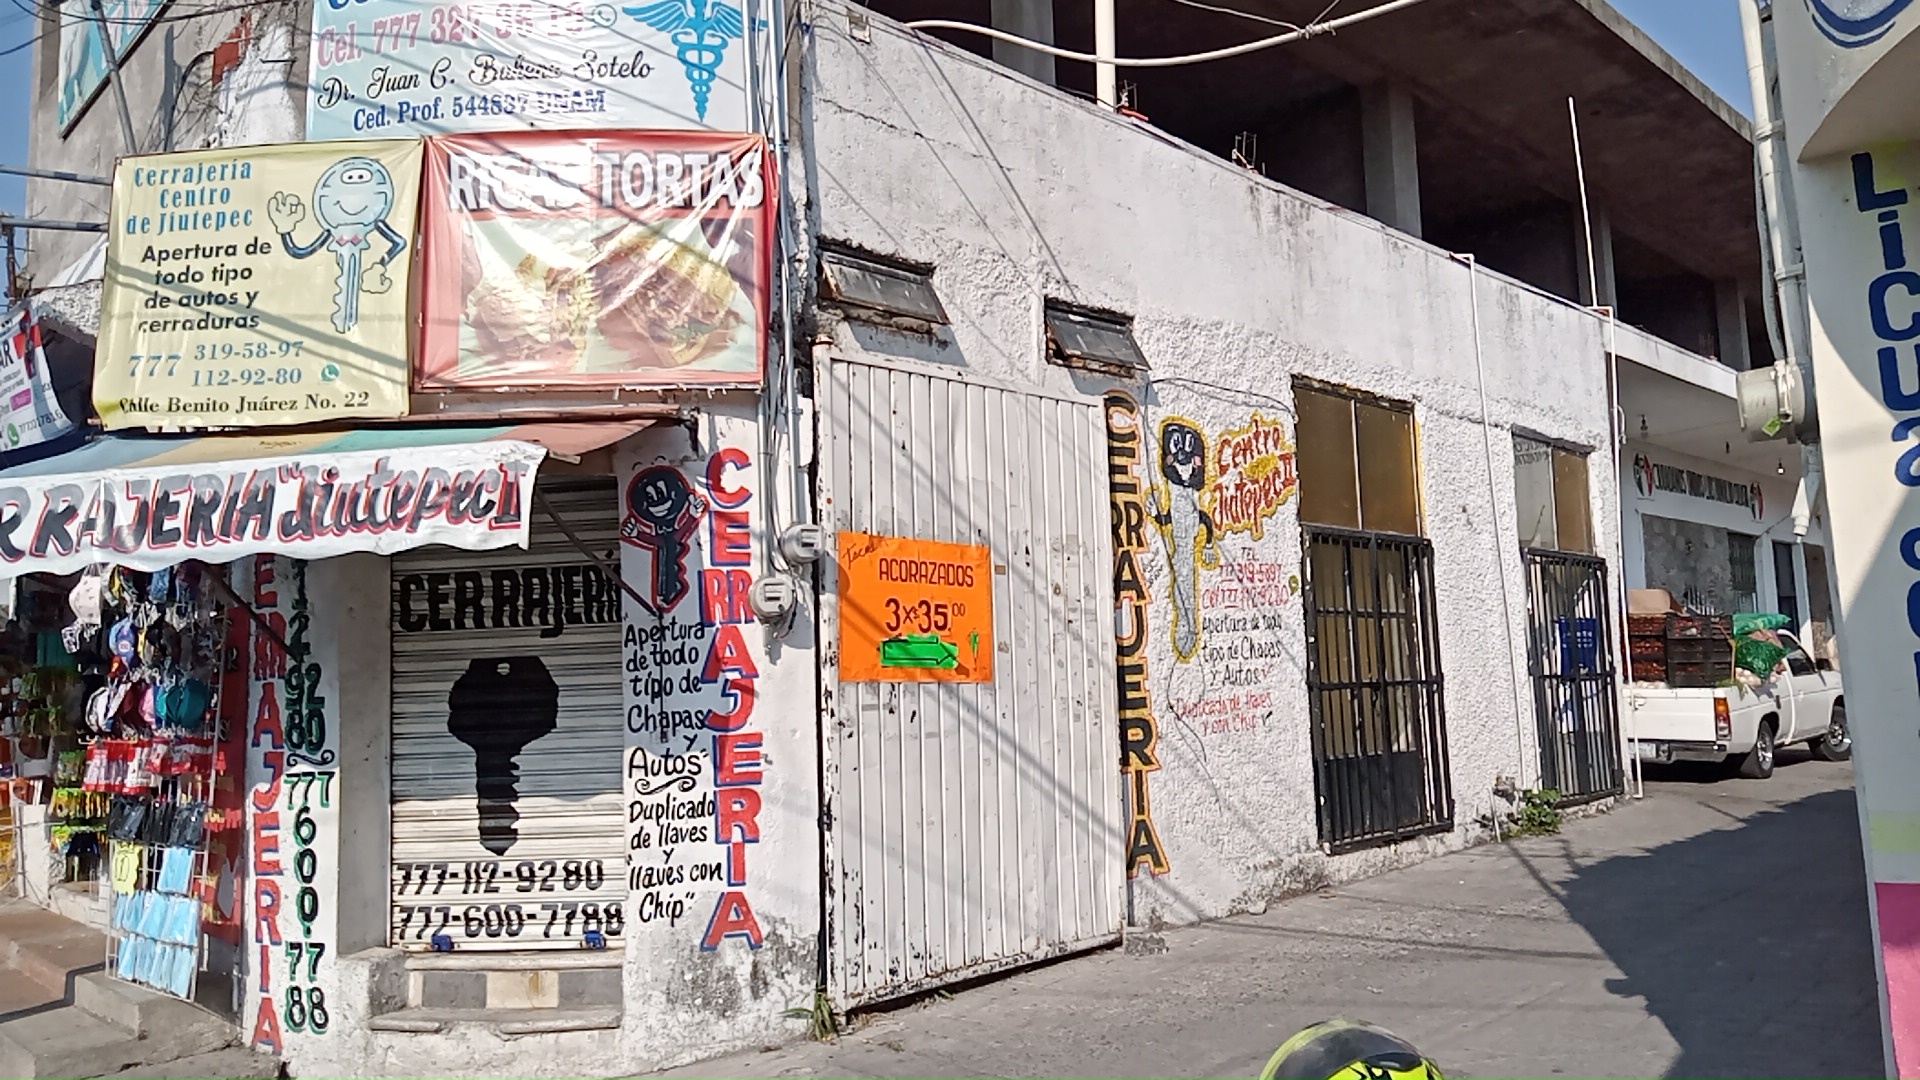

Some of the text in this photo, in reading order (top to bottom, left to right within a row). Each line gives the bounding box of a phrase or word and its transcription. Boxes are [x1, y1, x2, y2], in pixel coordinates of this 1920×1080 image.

[317, 23, 362, 67] Cel.
[374, 12, 421, 54] 777
[317, 77, 355, 109] Dr.
[366, 66, 420, 100] Juan
[573, 50, 655, 82] Sotelo
[354, 107, 391, 131] Ced.
[397, 97, 445, 124] Prof.
[596, 149, 764, 209] TORTAS
[160, 186, 231, 209] Centro
[127, 208, 253, 236] de Jiutepec
[141, 237, 272, 267] Apertura de
[154, 263, 253, 286] todo tipo
[145, 290, 260, 310] de autos y
[138, 311, 260, 334] cerraduras
[194, 340, 305, 361] 319-58-97
[128, 354, 182, 378] 777
[191, 367, 303, 387] 112-92-80
[166, 395, 230, 414] Benito
[235, 393, 299, 415] Juárez
[304, 391, 337, 410] No.
[344, 391, 370, 408] 22
[1218, 418, 1282, 477] Centro
[879, 558, 974, 588] ACORAZADOS
[626, 641, 699, 672] de todo
[629, 668, 702, 704] tipo de
[1222, 664, 1261, 687] Autos
[628, 704, 705, 737] Chapas
[284, 771, 335, 811] 777
[629, 792, 715, 826] Duplicado
[631, 823, 708, 849] de llaves
[690, 862, 724, 882] con
